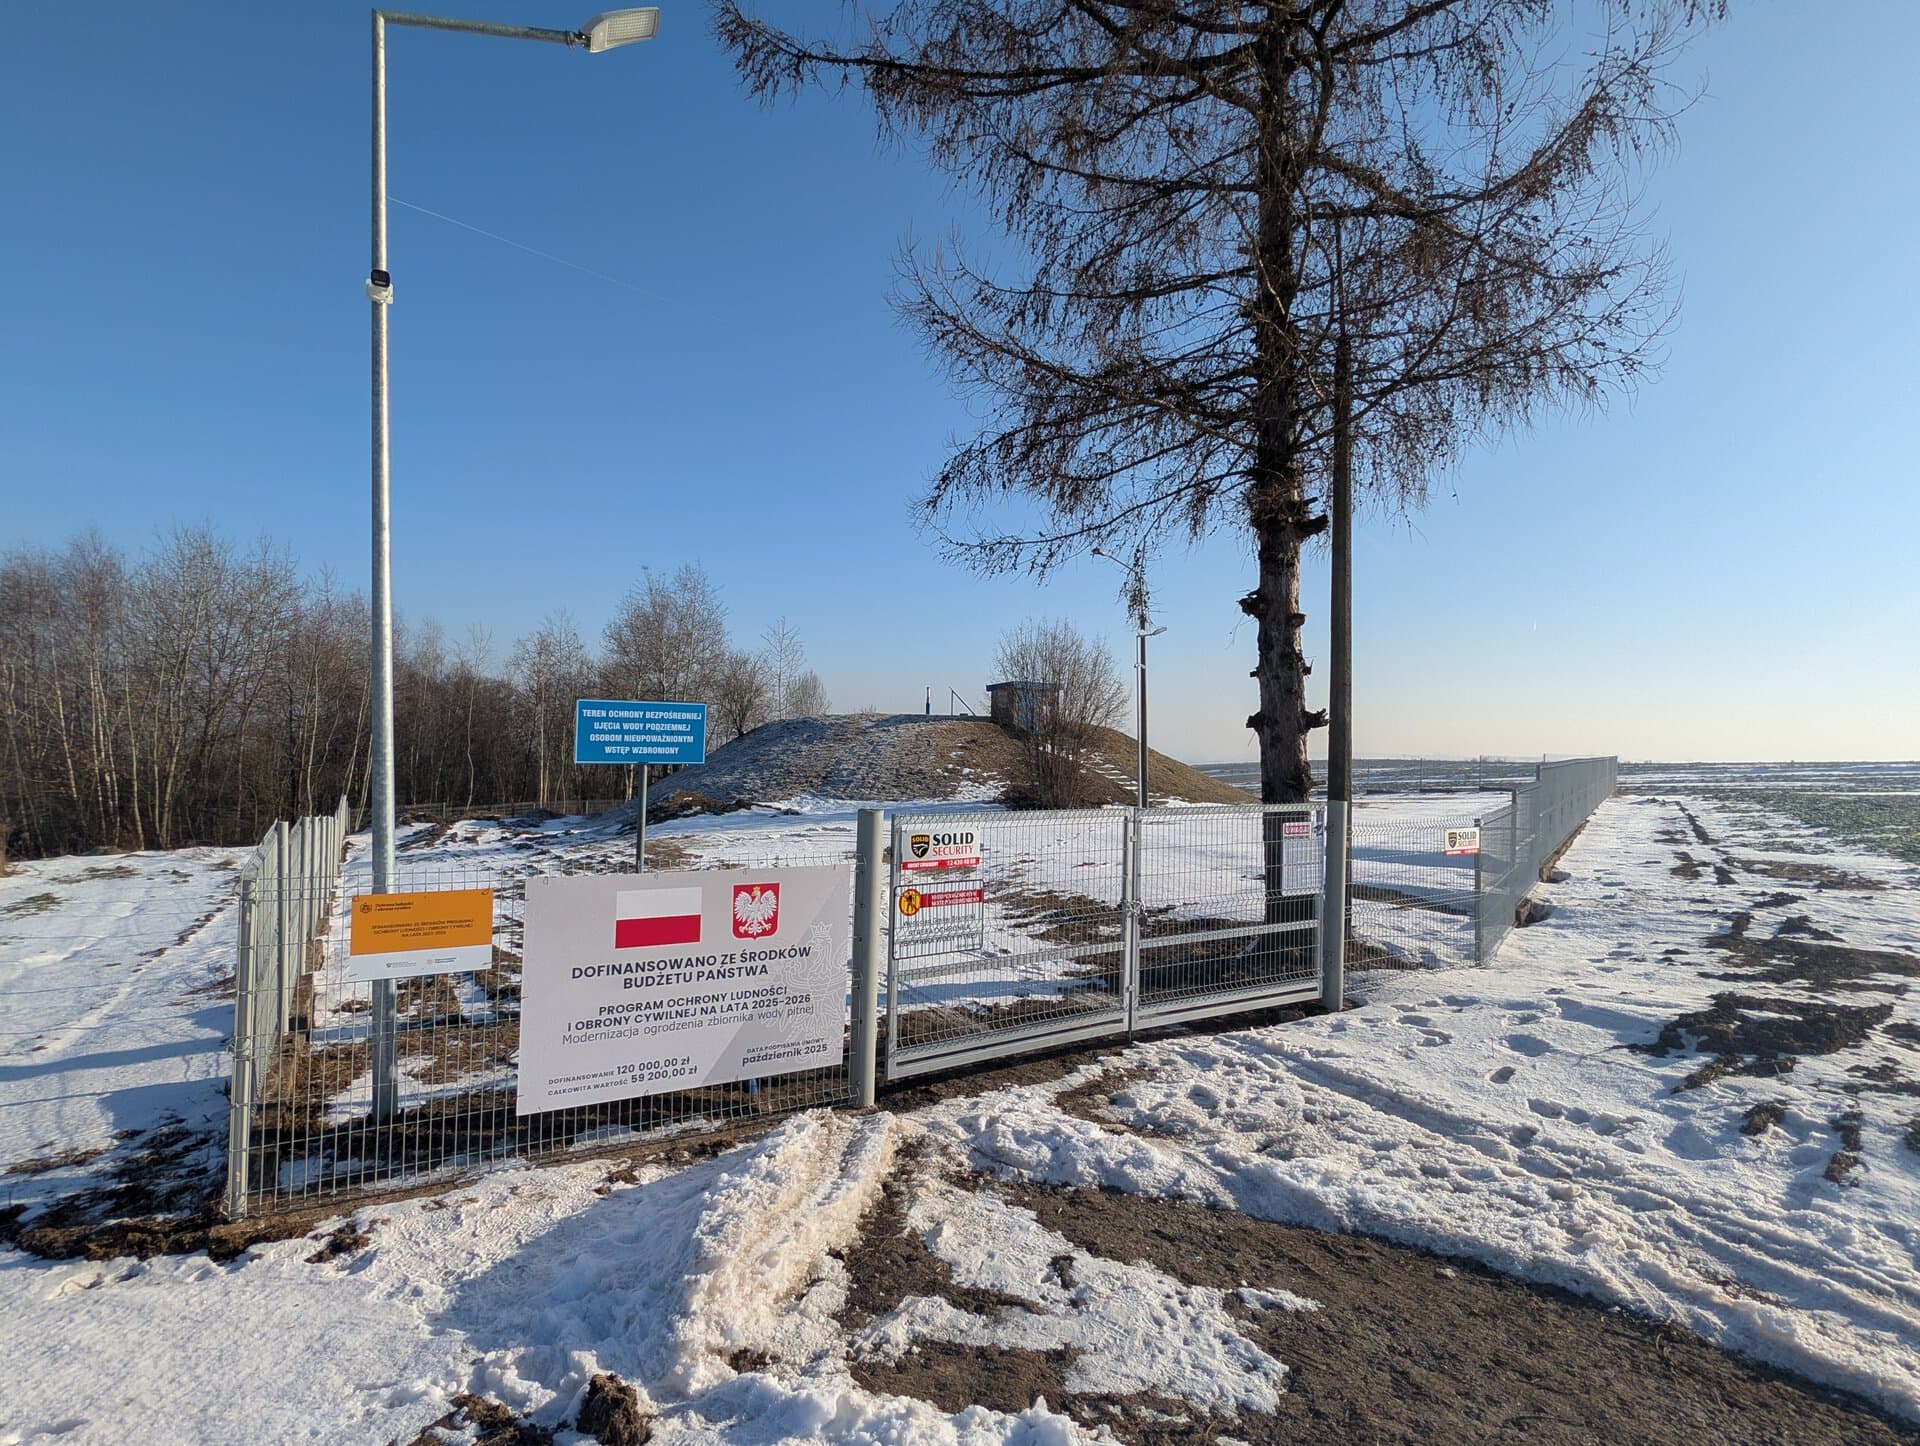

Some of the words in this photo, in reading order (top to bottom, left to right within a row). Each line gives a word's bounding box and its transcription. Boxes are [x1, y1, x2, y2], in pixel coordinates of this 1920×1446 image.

[582, 709, 606, 718] TEREN
[608, 710, 644, 719] OCHRONY
[645, 710, 702, 720] BEZPOŚREDNIEJ
[593, 722, 621, 731] UJĘCIA
[622, 722, 644, 730] WODY
[645, 723, 691, 731] PODZIEMNEJ
[590, 733, 622, 742] OSOBOM
[604, 746, 630, 755] WSTĘP
[932, 832, 974, 846] SOLID
[1458, 831, 1476, 840] SOLID
[932, 845, 974, 857] SECURITY
[571, 955, 717, 979] DOFINANSOWANO
[720, 953, 736, 965] ZE
[740, 944, 811, 963] ŚRODKÓW
[623, 972, 693, 989] BUDŻETU
[696, 964, 768, 982] PAŃSTWA
[599, 1000, 663, 1016] PROGRAM
[667, 993, 728, 1008] OCHRONY
[730, 984, 787, 1001] LUDNOŚCI
[567, 1022, 571, 1032] I
[575, 1016, 631, 1031] OBRONY
[634, 1008, 697, 1024] CYWILNEJ
[700, 1005, 717, 1019] NA
[720, 1001, 749, 1013] LATA
[752, 994, 811, 1010] 2025-2026
[562, 1026, 639, 1045] Modernizacja
[644, 1018, 703, 1035] ogrodzenia
[707, 1013, 754, 1027] zbiornika
[757, 1009, 784, 1021] wody
[787, 1005, 814, 1019] pitnej
[742, 1047, 802, 1067] październik
[804, 1043, 828, 1055] 2025
[747, 1046, 764, 1054] DATA
[548, 1070, 614, 1085] DOFINANSOWANIE
[616, 1064, 635, 1075] 120
[638, 1058, 678, 1072] 000,00
[680, 1056, 690, 1066] zł
[548, 1084, 592, 1096] CAŁKOWITA
[593, 1078, 628, 1090] WARTOŚĆ
[631, 1073, 645, 1083] 59
[648, 1066, 686, 1081] 200,00
[688, 1065, 697, 1075] zł
